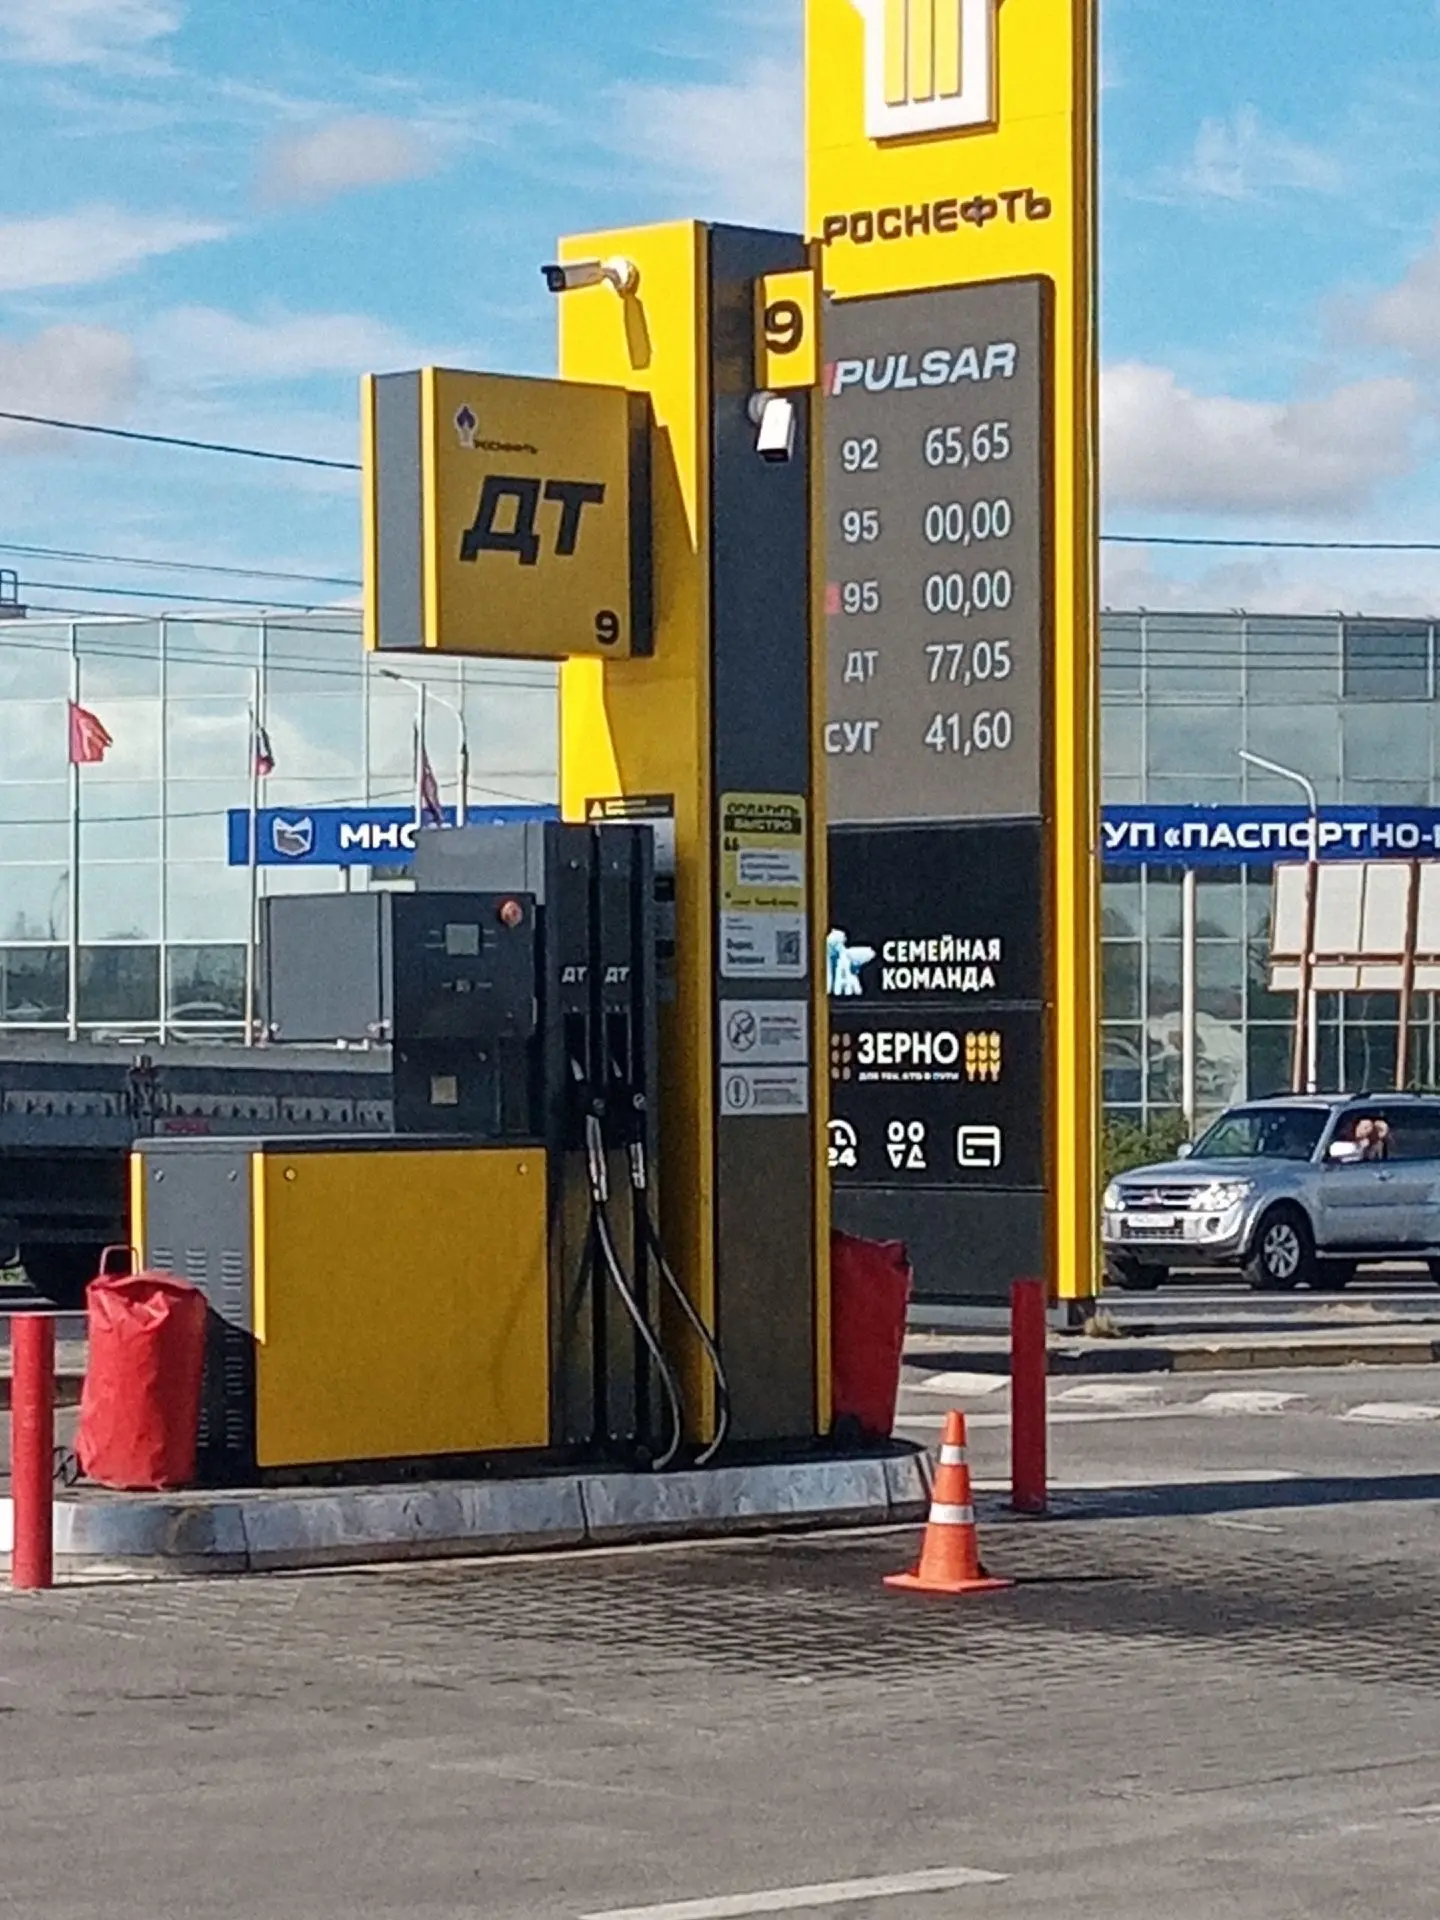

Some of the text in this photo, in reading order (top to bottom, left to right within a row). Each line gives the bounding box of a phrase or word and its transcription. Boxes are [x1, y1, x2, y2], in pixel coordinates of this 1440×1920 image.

[822, 187, 1052, 247] РОСНЕФТЬ
[763, 300, 804, 355] 9
[831, 342, 1017, 396] PULSAR
[842, 421, 1011, 472] 92 65,65
[459, 475, 606, 566] ДТ
[842, 499, 1012, 546] 95 00,00
[843, 569, 1012, 617] 95 00,00
[594, 610, 620, 646] 9
[843, 640, 1012, 687] ДТ 77,05
[824, 710, 1012, 756] СУГ 41,60
[882, 935, 1001, 964] СЕМЕЙНАЯ
[561, 966, 588, 983] ДТ
[605, 966, 630, 983] ДТ
[882, 966, 996, 992] КОМАНДА
[857, 1032, 960, 1064] ЗЕРНО
